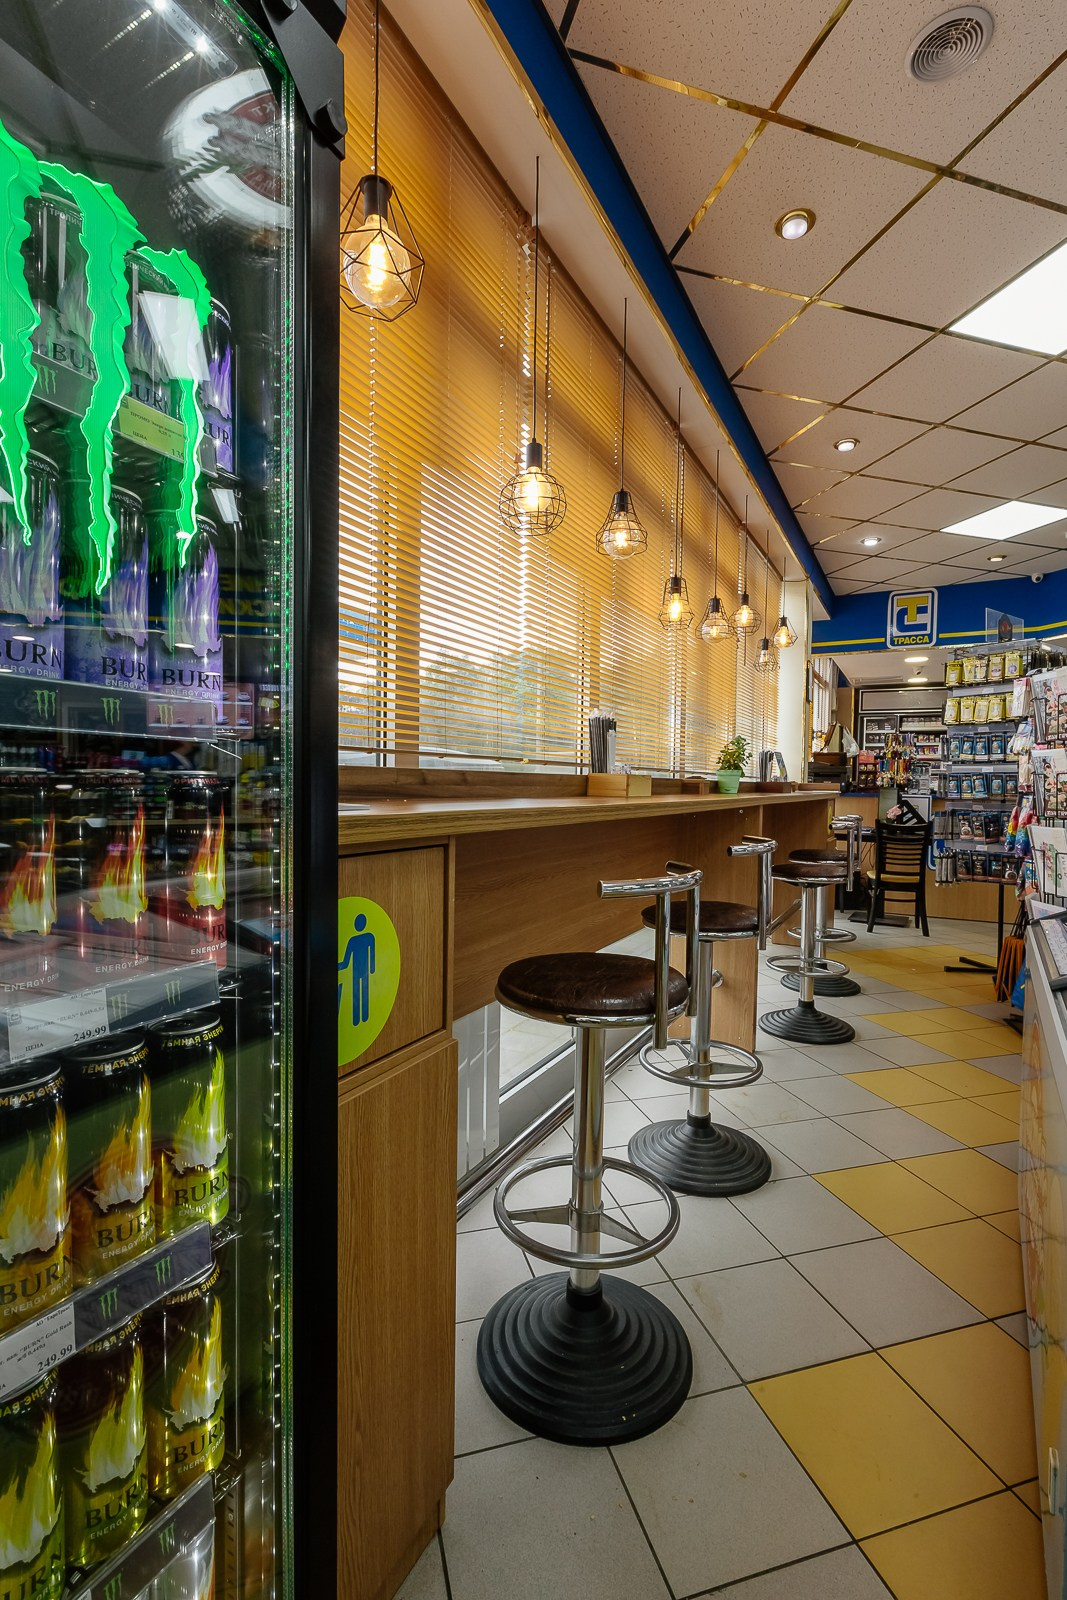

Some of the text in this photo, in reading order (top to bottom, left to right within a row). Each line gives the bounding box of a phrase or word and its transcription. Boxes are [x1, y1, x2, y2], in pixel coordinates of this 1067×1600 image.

[204, 422, 229, 448] UR
[893, 635, 930, 645] ТРАССА
[0, 639, 62, 670] URN
[0, 664, 33, 675] ERGY
[161, 668, 222, 691] BURN
[190, 944, 220, 955] ENERGY
[95, 961, 133, 973] ENERGY
[5, 977, 45, 992] ENERGY
[73, 1025, 107, 1042] 249.99
[102, 1238, 139, 1259] ENERGY
[3, 1292, 47, 1317] ENERGY
[37, 1344, 73, 1373] 249.99
[177, 1453, 209, 1474] ENERGY
[90, 1513, 128, 1540] ENERGY
